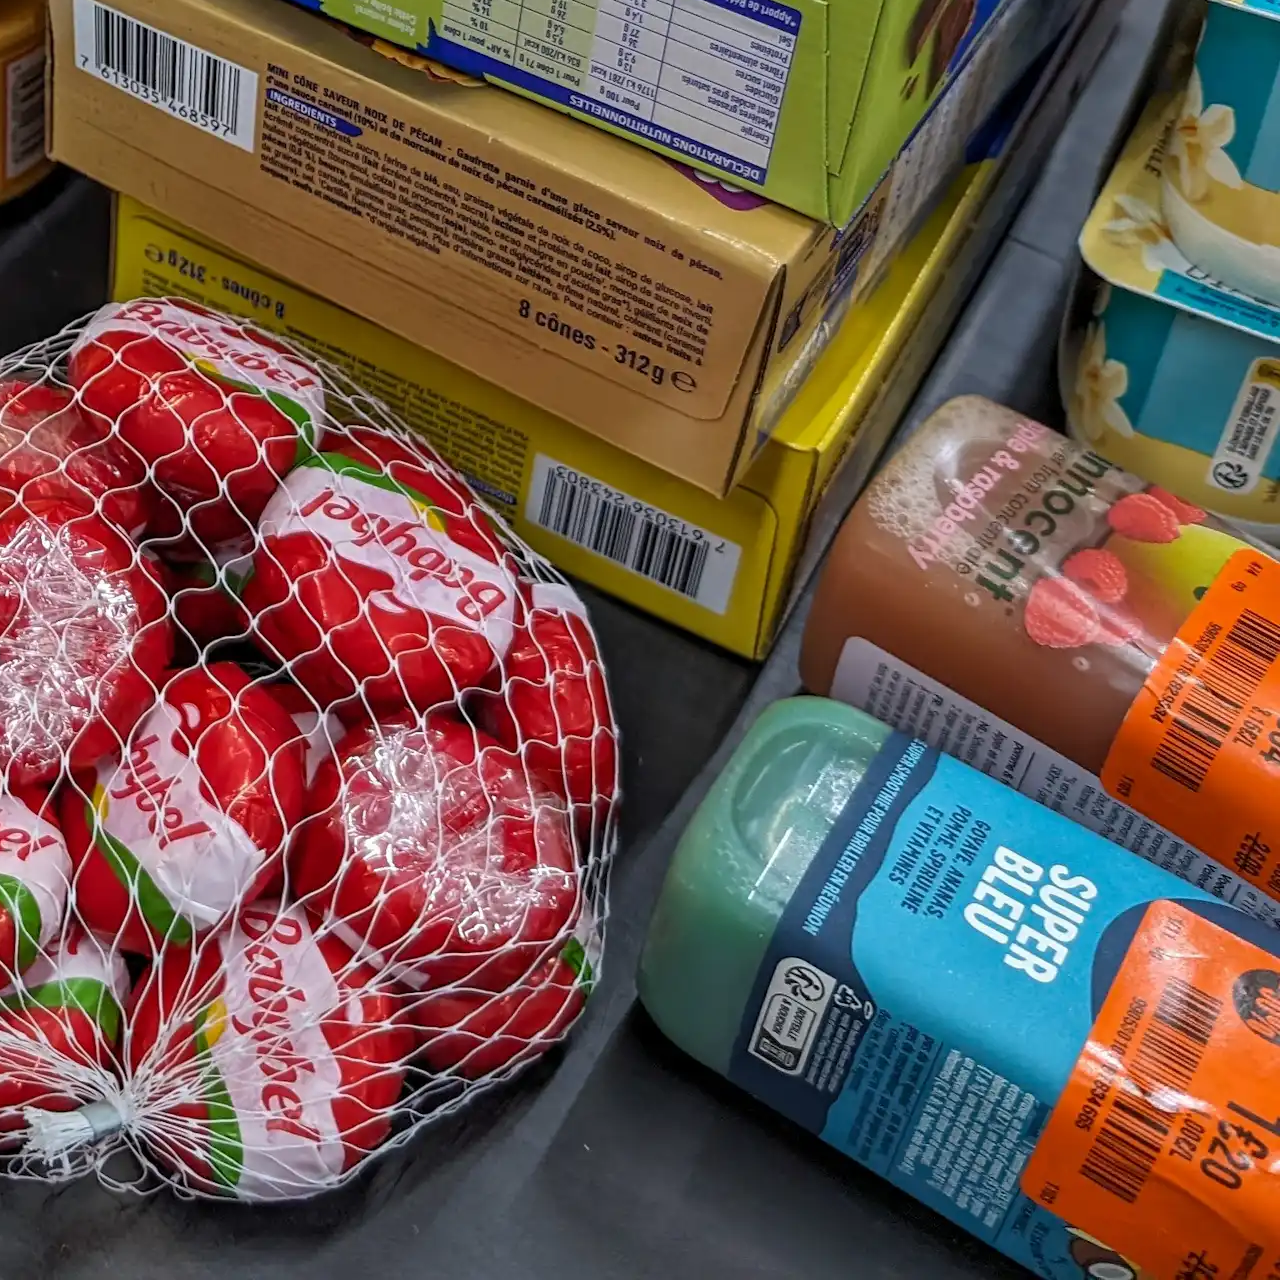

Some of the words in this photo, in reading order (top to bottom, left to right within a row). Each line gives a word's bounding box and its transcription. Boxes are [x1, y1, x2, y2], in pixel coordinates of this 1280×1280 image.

[708, 41, 758, 70] alimentaires
[749, 40, 788, 64] Protéines
[778, 34, 793, 48] Sel
[680, 73, 710, 94] saturés
[734, 67, 760, 86] sucres
[759, 61, 784, 80] Fibres
[760, 78, 781, 95] dont
[79, 54, 89, 70] 7
[93, 64, 163, 107] 613035
[167, 95, 234, 137] 468597
[270, 88, 336, 127] INGREDIENTS
[706, 93, 736, 114] grasses
[711, 85, 729, 100] gras
[728, 94, 754, 113] acides
[743, 82, 779, 105] Glucides
[569, 90, 671, 146] NUTRITIONNELLES
[736, 107, 773, 131] Matières
[754, 104, 775, 121] dont
[267, 61, 288, 80] MINI
[293, 71, 318, 92] CÔNE
[323, 86, 359, 111] SAVEUR
[364, 105, 387, 124] NOIX
[391, 118, 404, 131] DE
[410, 125, 441, 148] PÉCAN
[456, 148, 499, 175] Gaufrette
[504, 171, 535, 193] garnie
[540, 186, 568, 206] d'une
[572, 201, 601, 223] glace
[605, 217, 639, 239] saveur
[643, 235, 666, 252] noix
[670, 248, 684, 261] de
[672, 133, 759, 182] DÉCLARATIONS
[222, 277, 271, 309] cônes
[275, 301, 285, 319] 8
[518, 299, 531, 319] 8
[534, 309, 596, 351] cônes
[116, 300, 315, 394] Babybel
[990, 447, 1020, 476] &
[627, 500, 707, 542] 613036
[903, 461, 1007, 573] raspberry
[303, 487, 508, 625] Babybel
[713, 539, 727, 554] 7
[898, 739, 925, 769] SUPER
[873, 761, 911, 812] SMOOTHIE
[858, 804, 885, 836] POUR
[921, 803, 945, 827] ET
[942, 804, 971, 858] POMME,
[836, 829, 871, 875] BRILLER
[889, 826, 934, 888] VITAMINES
[958, 819, 992, 867] GOYAVE,
[828, 868, 848, 888] EN
[902, 853, 952, 917] SPIRULINE
[933, 860, 971, 921] ANANAS,
[962, 845, 1045, 945] BLEU
[800, 881, 844, 938] RÉUNION
[998, 860, 1105, 988] SUPER
[236, 909, 311, 1139] Babybel
